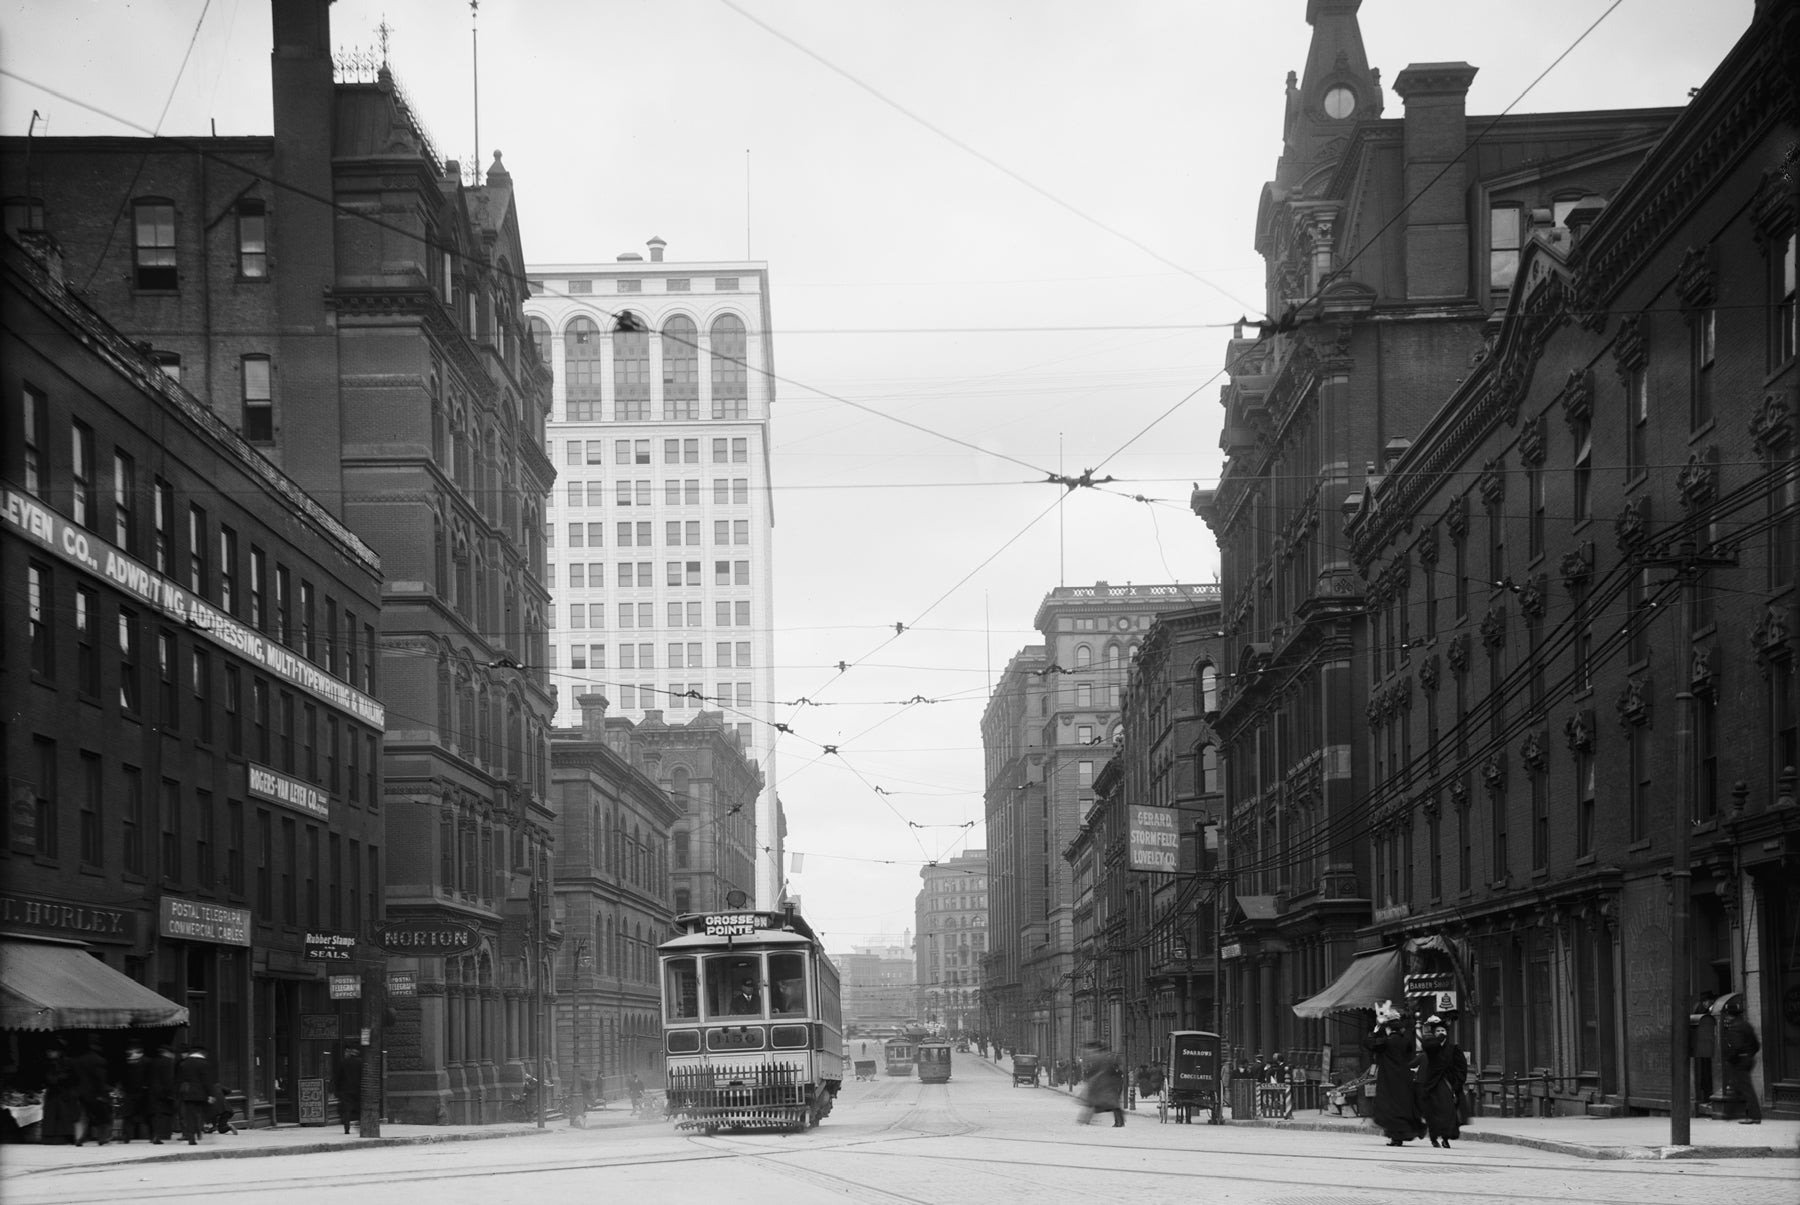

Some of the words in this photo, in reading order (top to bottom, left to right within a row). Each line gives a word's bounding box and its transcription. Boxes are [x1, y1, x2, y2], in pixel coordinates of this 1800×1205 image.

[189, 600, 265, 663] ADDRESSING,
[267, 643, 350, 708] MULTI-TYPEWRITING
[351, 696, 357, 713] &
[358, 695, 385, 727] MAILING
[25, 901, 124, 934] HURLEY.
[172, 902, 200, 919] POSTAL
[705, 914, 754, 926] GROSSE
[169, 920, 215, 938] COMMERCIAL
[706, 925, 754, 936] POINTE
[306, 933, 332, 945] Rubber
[332, 935, 356, 948] Stamps
[385, 930, 468, 946] NORTON
[1409, 982, 1433, 990] BARBER
